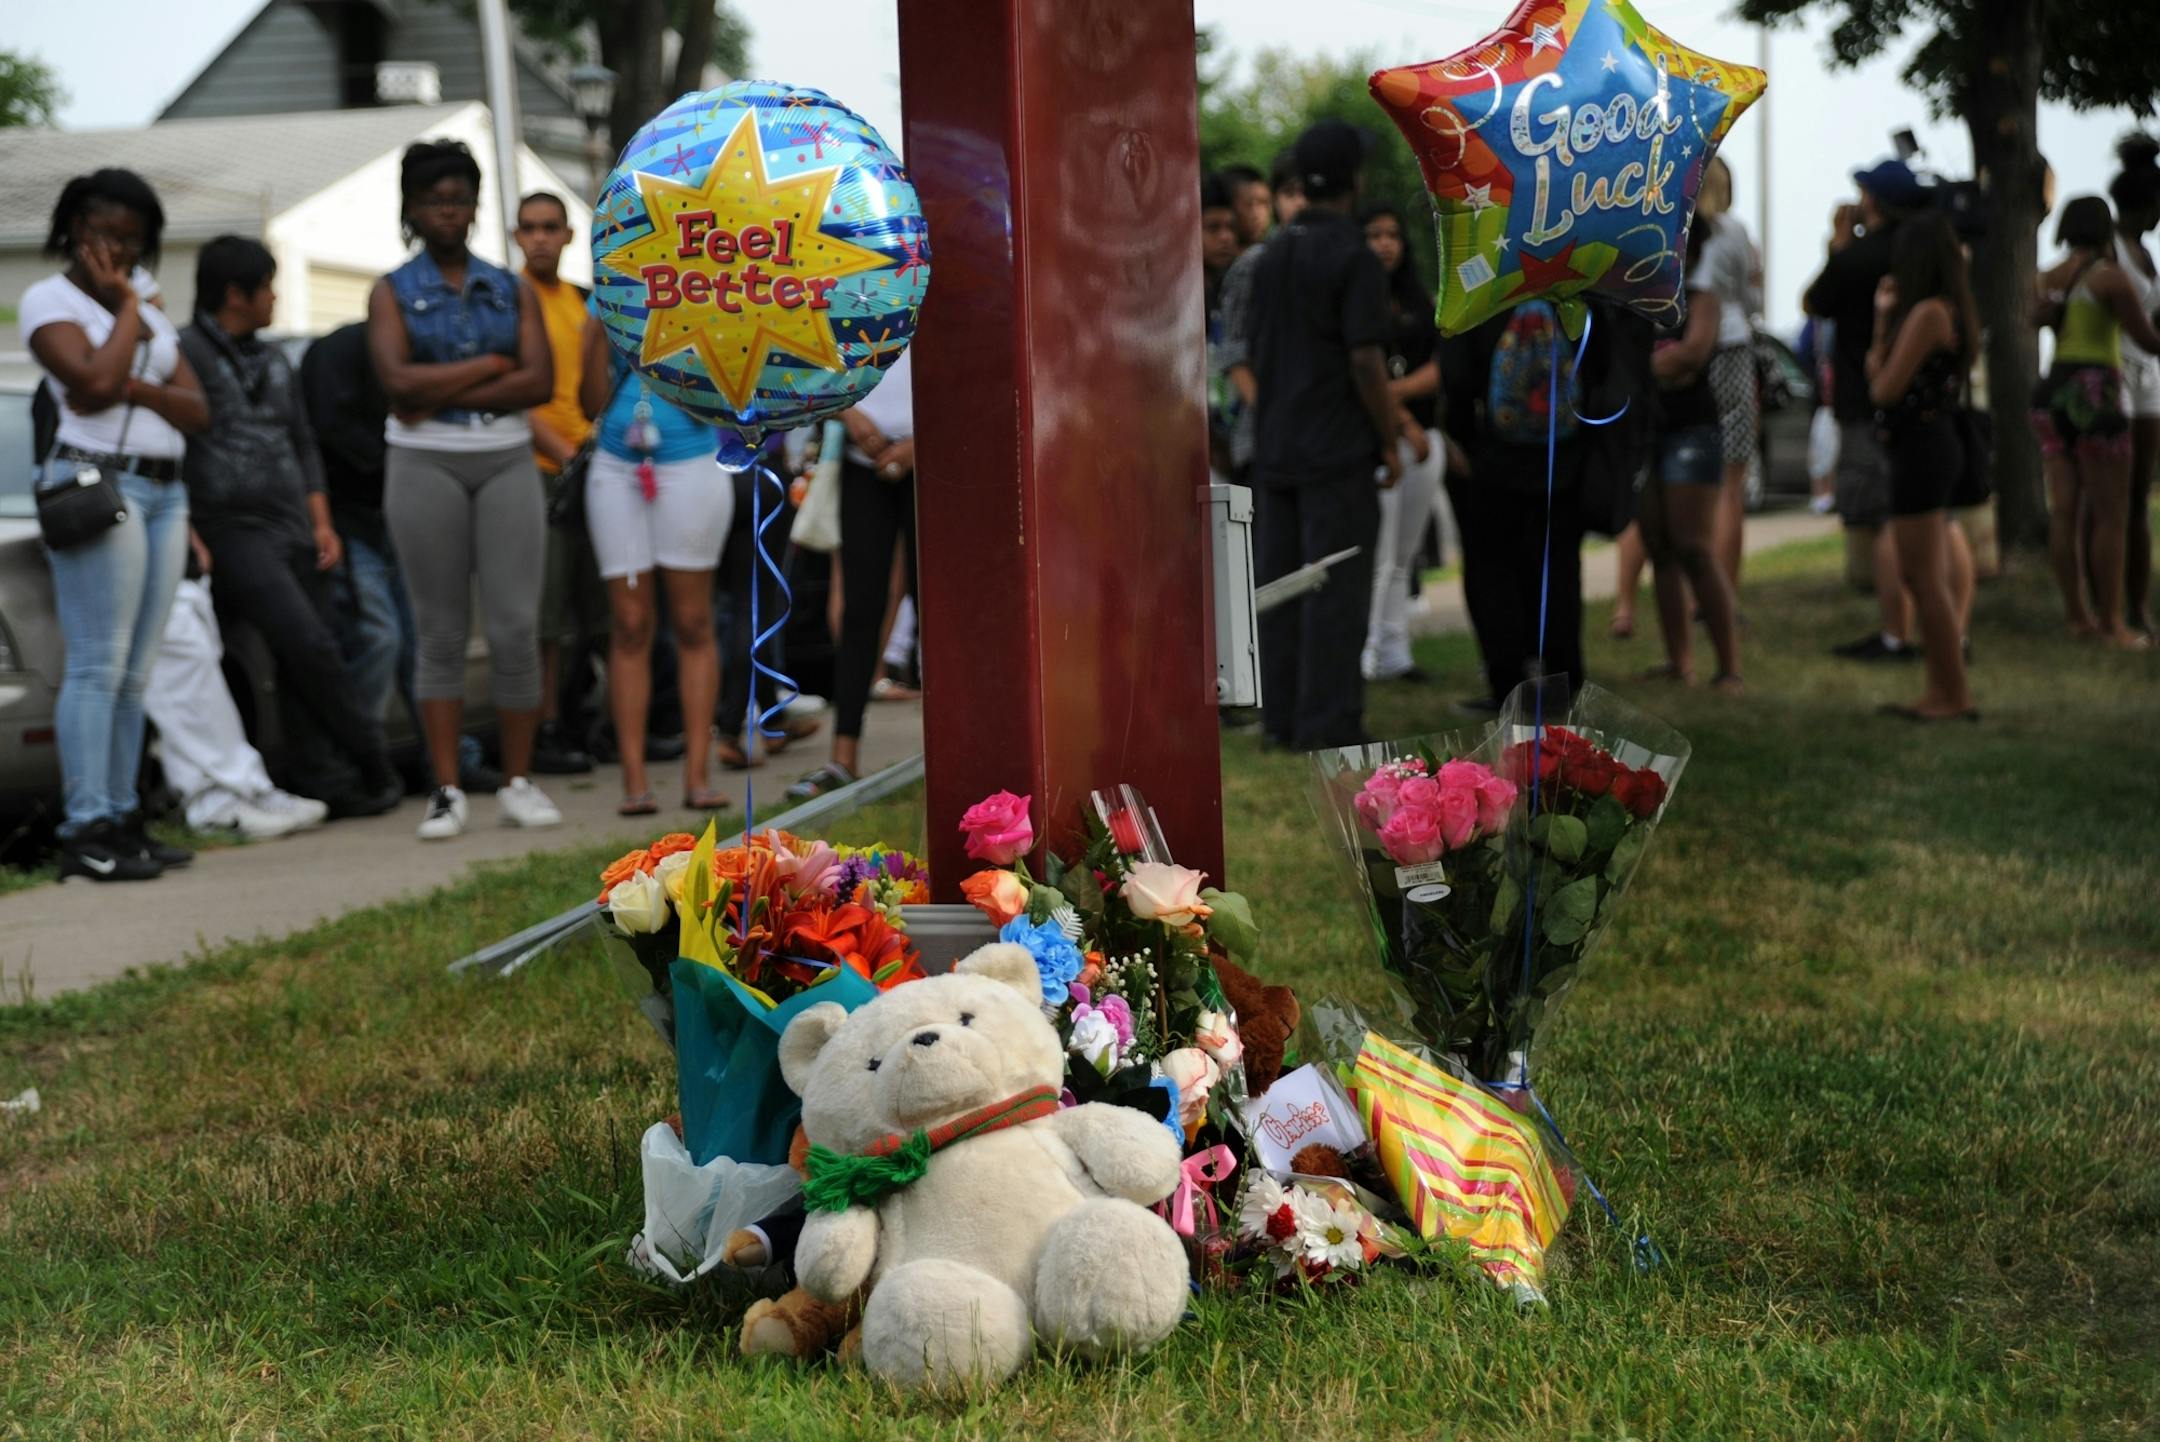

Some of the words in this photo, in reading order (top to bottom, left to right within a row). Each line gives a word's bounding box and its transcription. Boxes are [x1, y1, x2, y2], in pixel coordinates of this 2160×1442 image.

[1510, 52, 1682, 166] Good
[1523, 133, 1676, 246] Luck
[674, 208, 795, 266] Feel
[640, 263, 839, 313] Better
